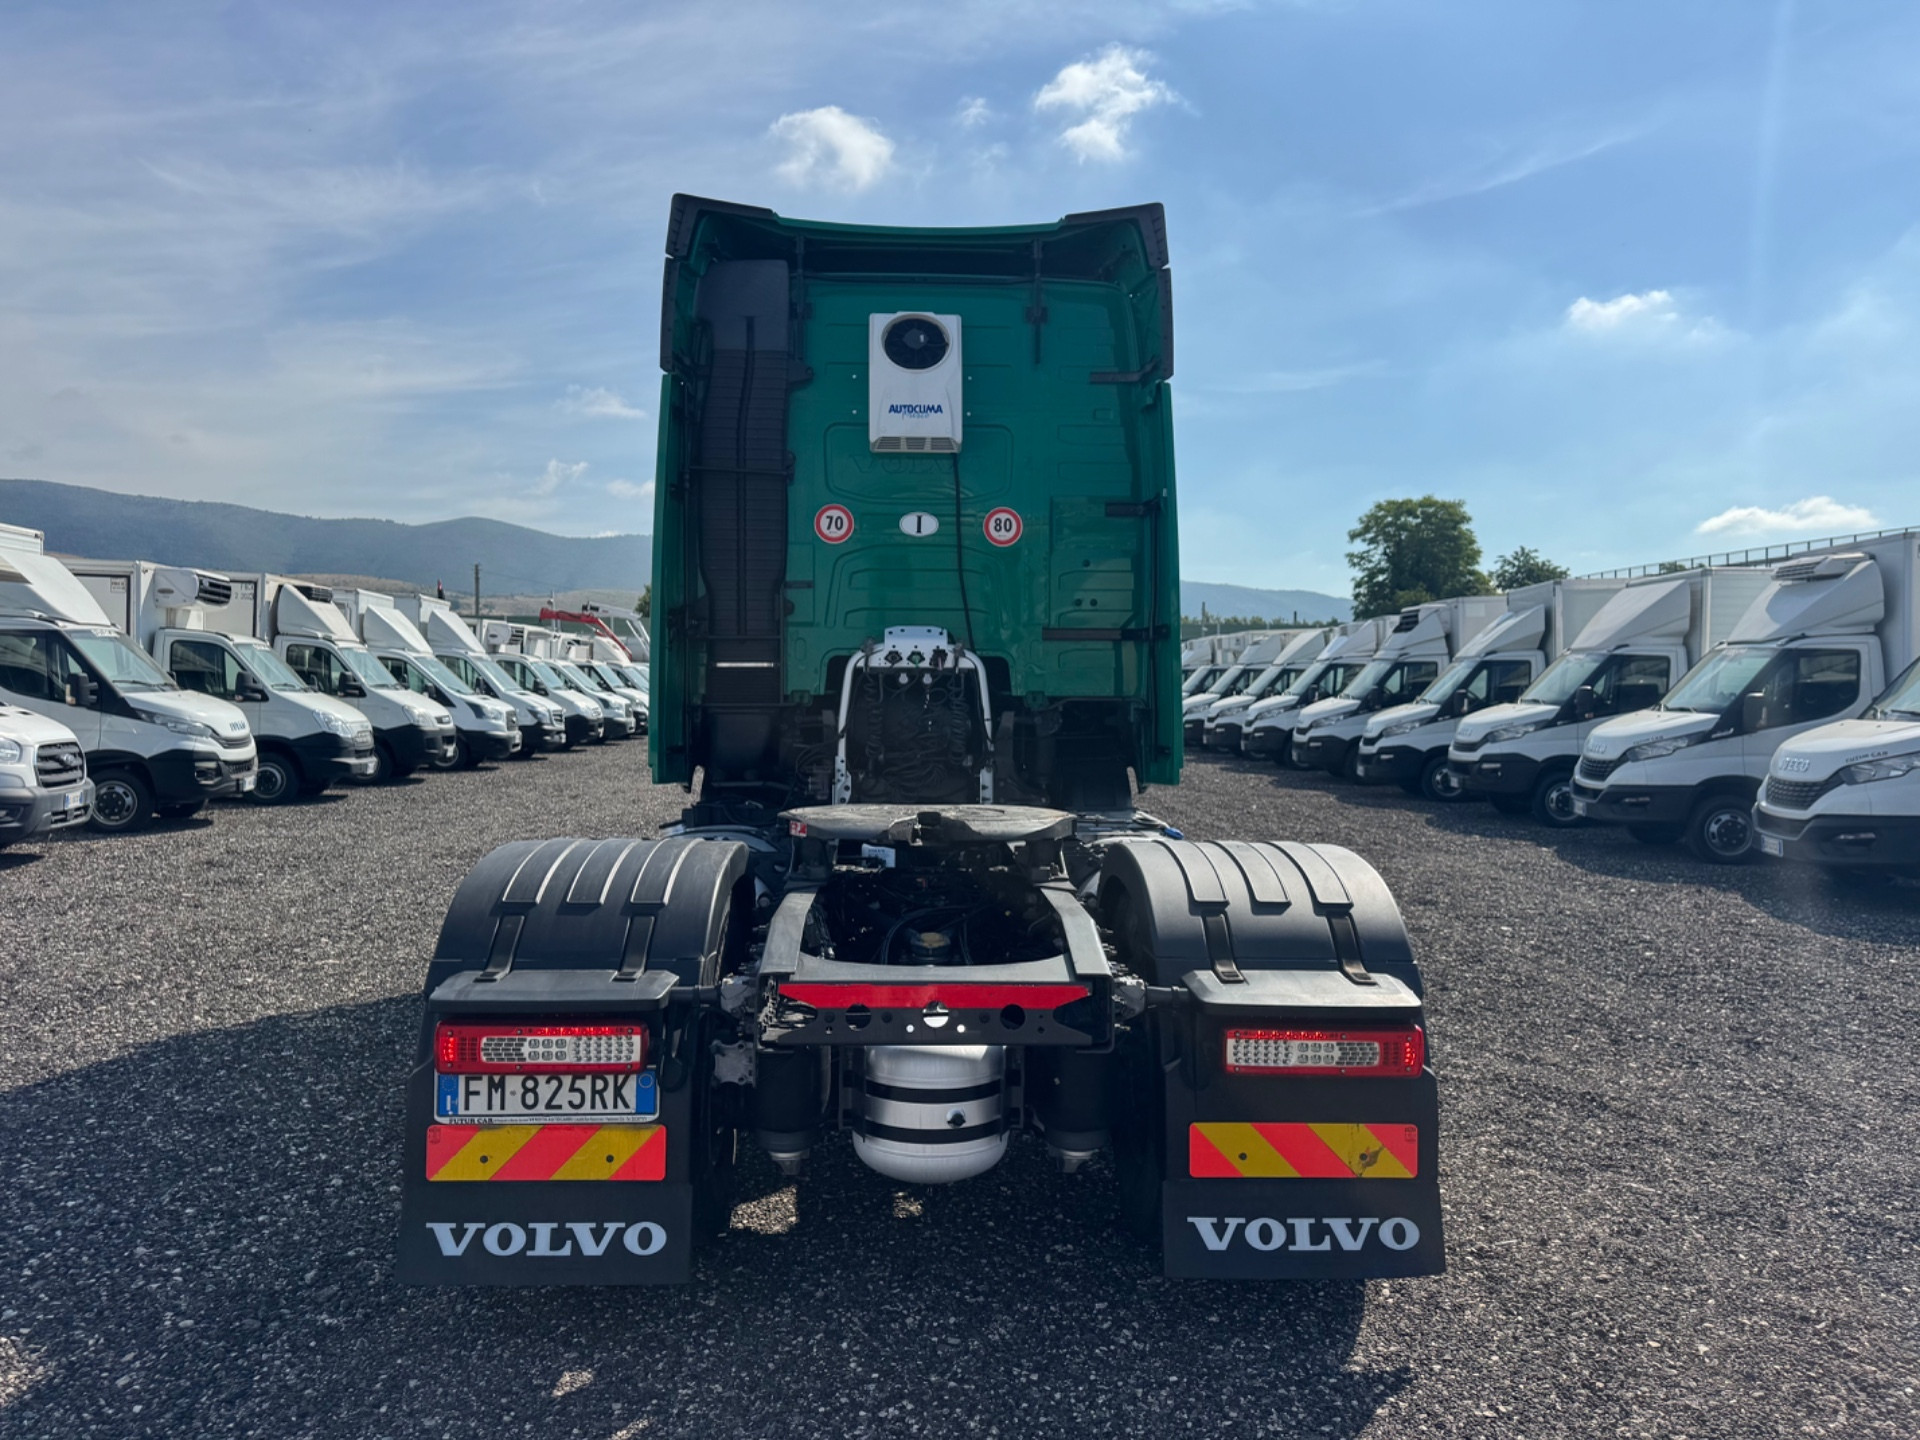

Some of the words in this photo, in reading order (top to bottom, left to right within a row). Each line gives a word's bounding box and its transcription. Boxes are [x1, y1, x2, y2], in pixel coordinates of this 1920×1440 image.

[889, 404, 943, 414] AUTOCLIMA
[826, 515, 844, 531] 70
[916, 515, 923, 533] I
[994, 517, 1012, 533] 80
[426, 1221, 667, 1257] VOLVO
[1187, 1216, 1420, 1251] VOLVO
